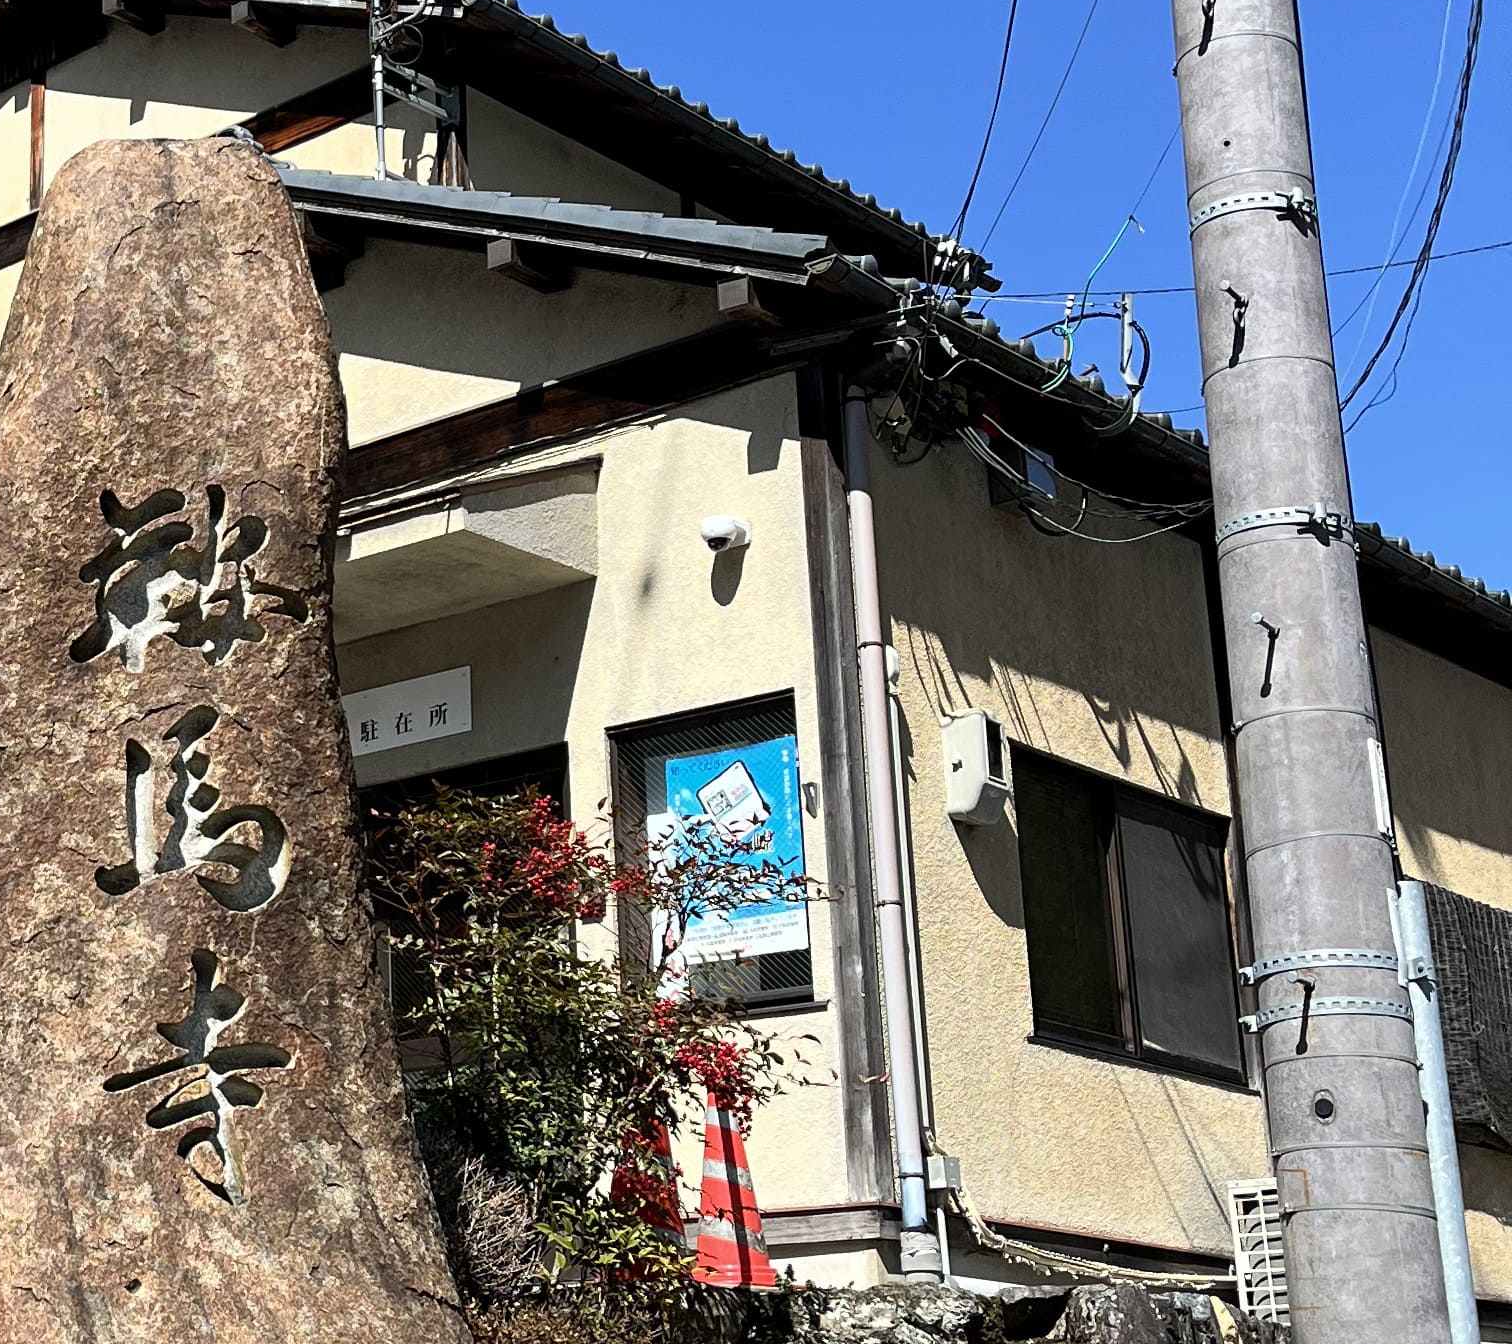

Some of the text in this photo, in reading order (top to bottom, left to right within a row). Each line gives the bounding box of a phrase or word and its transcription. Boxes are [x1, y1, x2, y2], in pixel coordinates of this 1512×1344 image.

[69, 484, 308, 1205] 鞍馬寺
[360, 702, 448, 742] 駐在所
